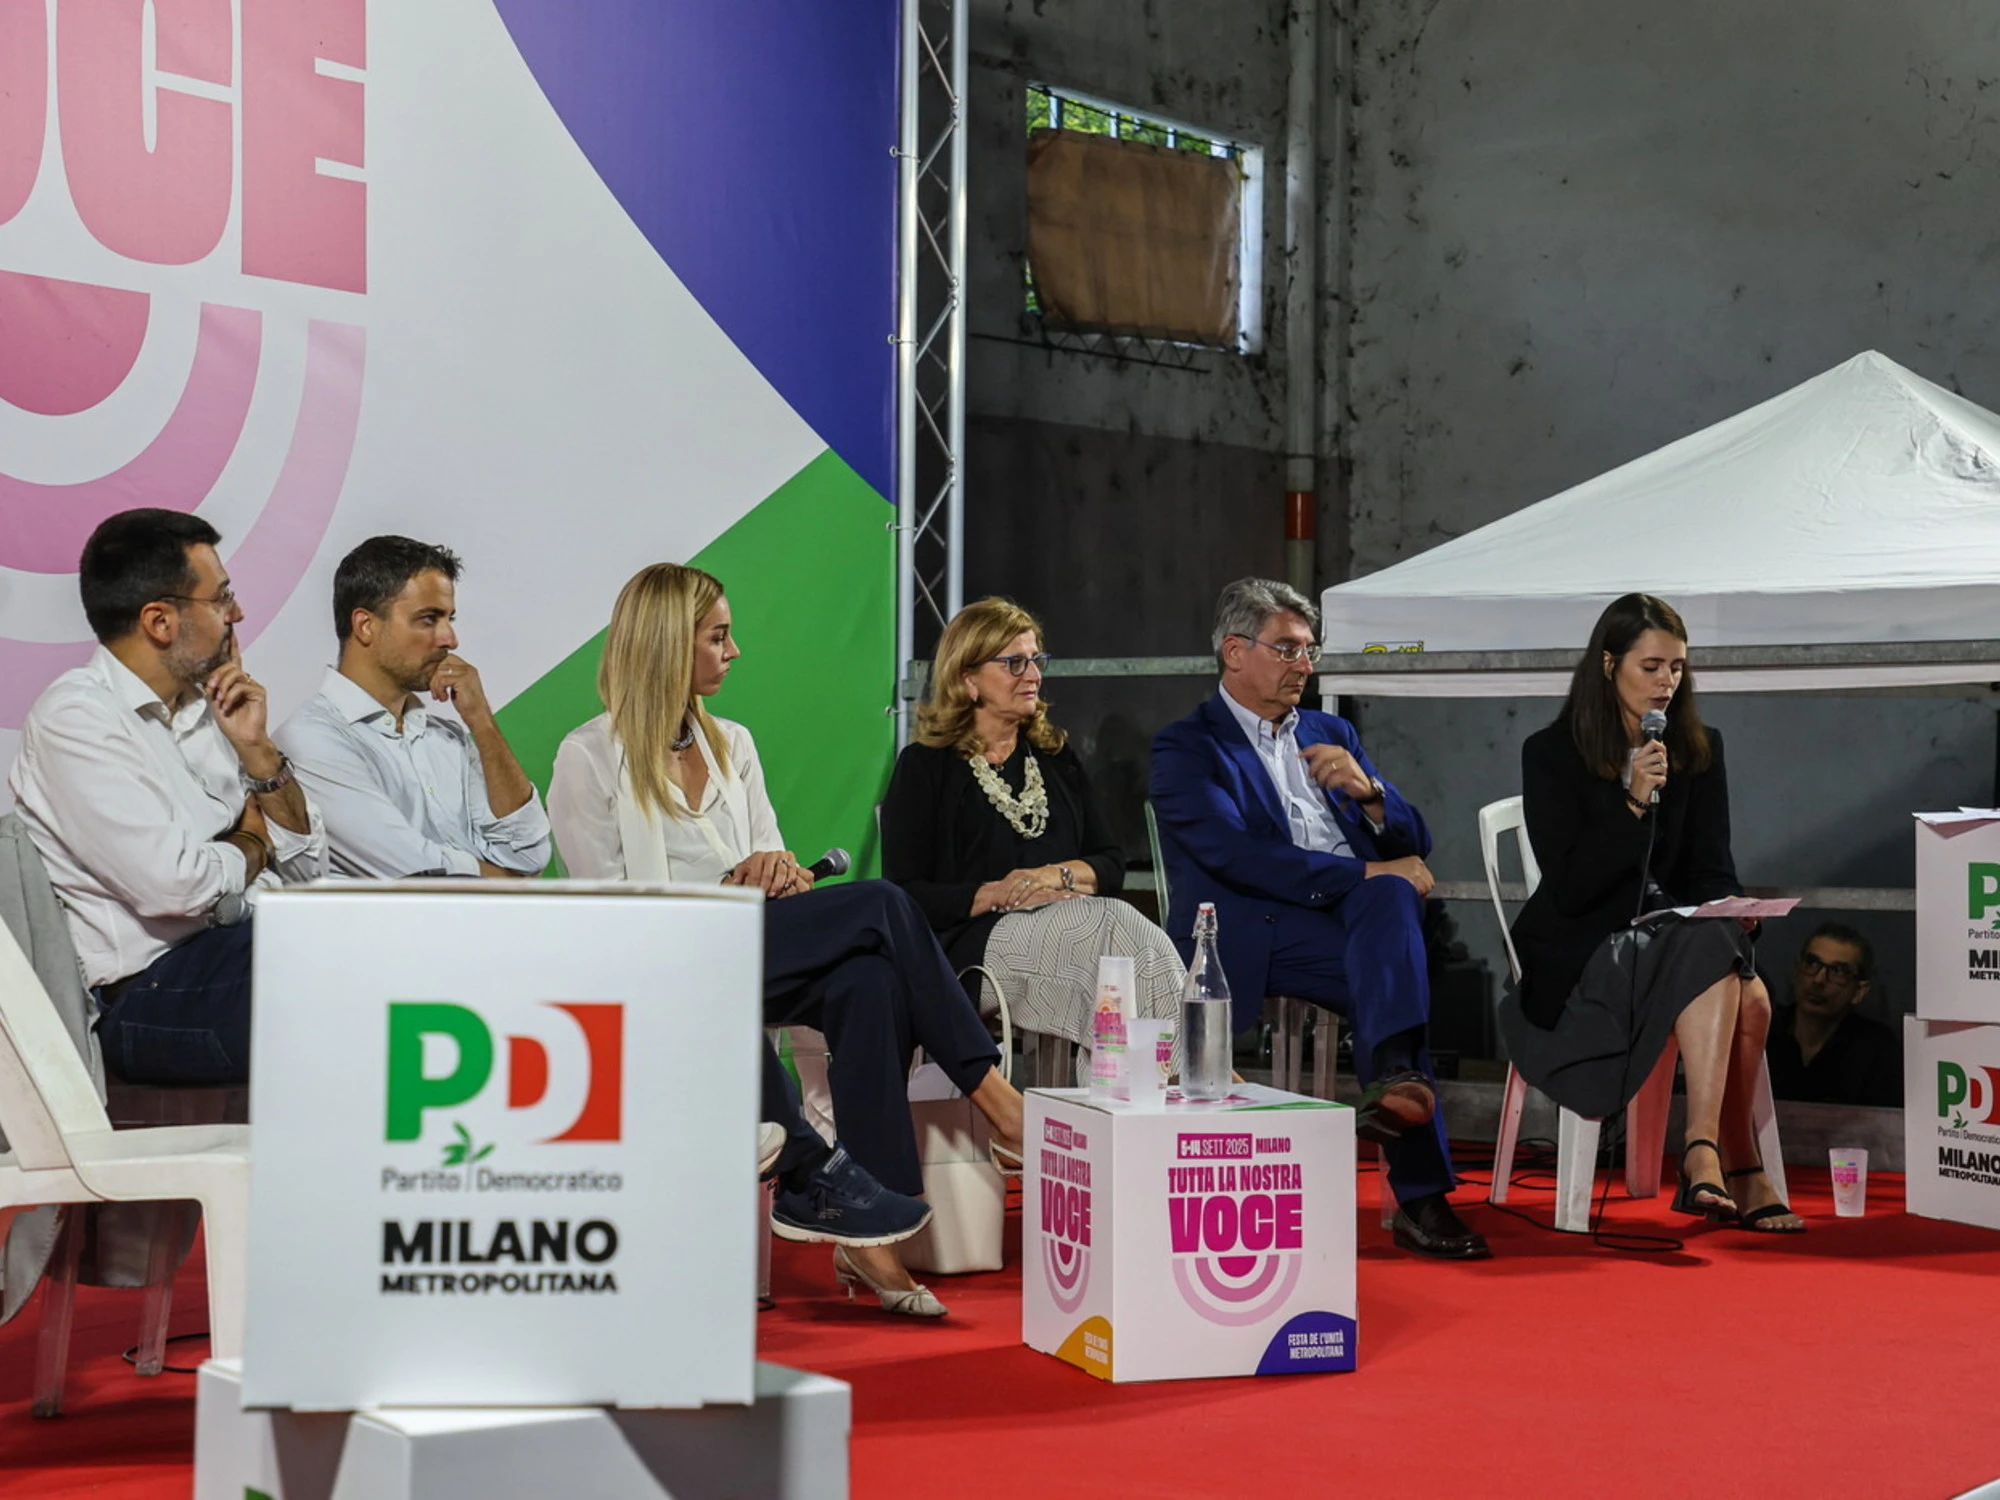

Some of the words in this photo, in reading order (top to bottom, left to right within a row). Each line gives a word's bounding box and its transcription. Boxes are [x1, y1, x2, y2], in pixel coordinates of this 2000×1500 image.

[0, 0, 367, 295] CE
[385, 1001, 624, 1144] PD
[1938, 1125, 1959, 1139] Partito
[1202, 1139, 1224, 1156] SETT
[1225, 1138, 1249, 1155] 2025
[1255, 1137, 1291, 1154] MILANO
[1938, 1145, 2000, 1174] MILANO
[380, 1167, 461, 1191] Partito
[476, 1167, 623, 1191] Democratico
[1168, 1166, 1215, 1194] TUTTA
[1218, 1165, 1236, 1192] LA
[1240, 1164, 1302, 1191] NOSTRA
[1040, 1177, 1091, 1248] VOCE
[1168, 1193, 1303, 1254] VOCE
[381, 1220, 619, 1264] MILANO
[380, 1274, 618, 1294] METROPOLITANA
[1288, 1333, 1308, 1347] FESTA
[1289, 1345, 1344, 1359] METROPOLITANA
